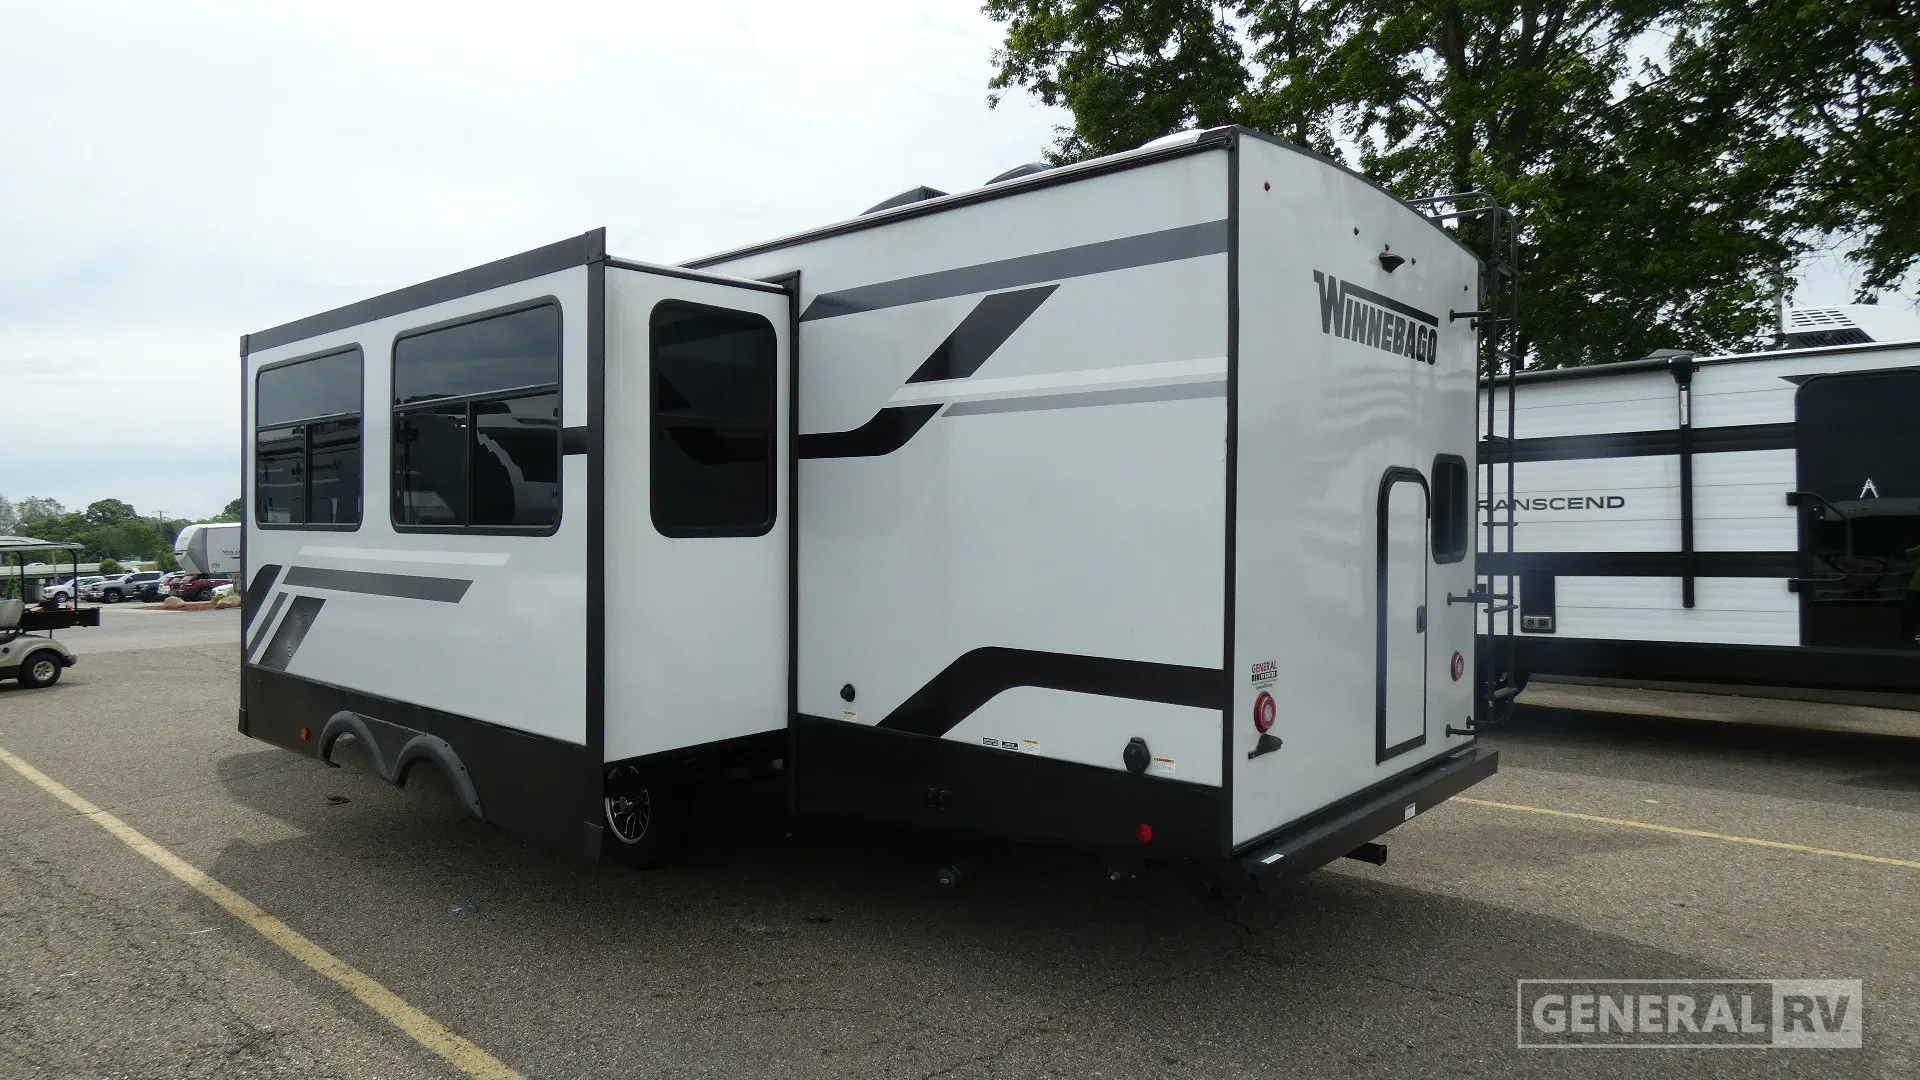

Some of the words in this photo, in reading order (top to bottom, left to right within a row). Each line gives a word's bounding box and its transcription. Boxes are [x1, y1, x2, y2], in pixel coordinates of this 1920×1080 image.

[1313, 269, 1439, 366] WINNEBAGO
[1477, 496, 1626, 511] RANSCEND
[1252, 660, 1278, 673] GENERAL
